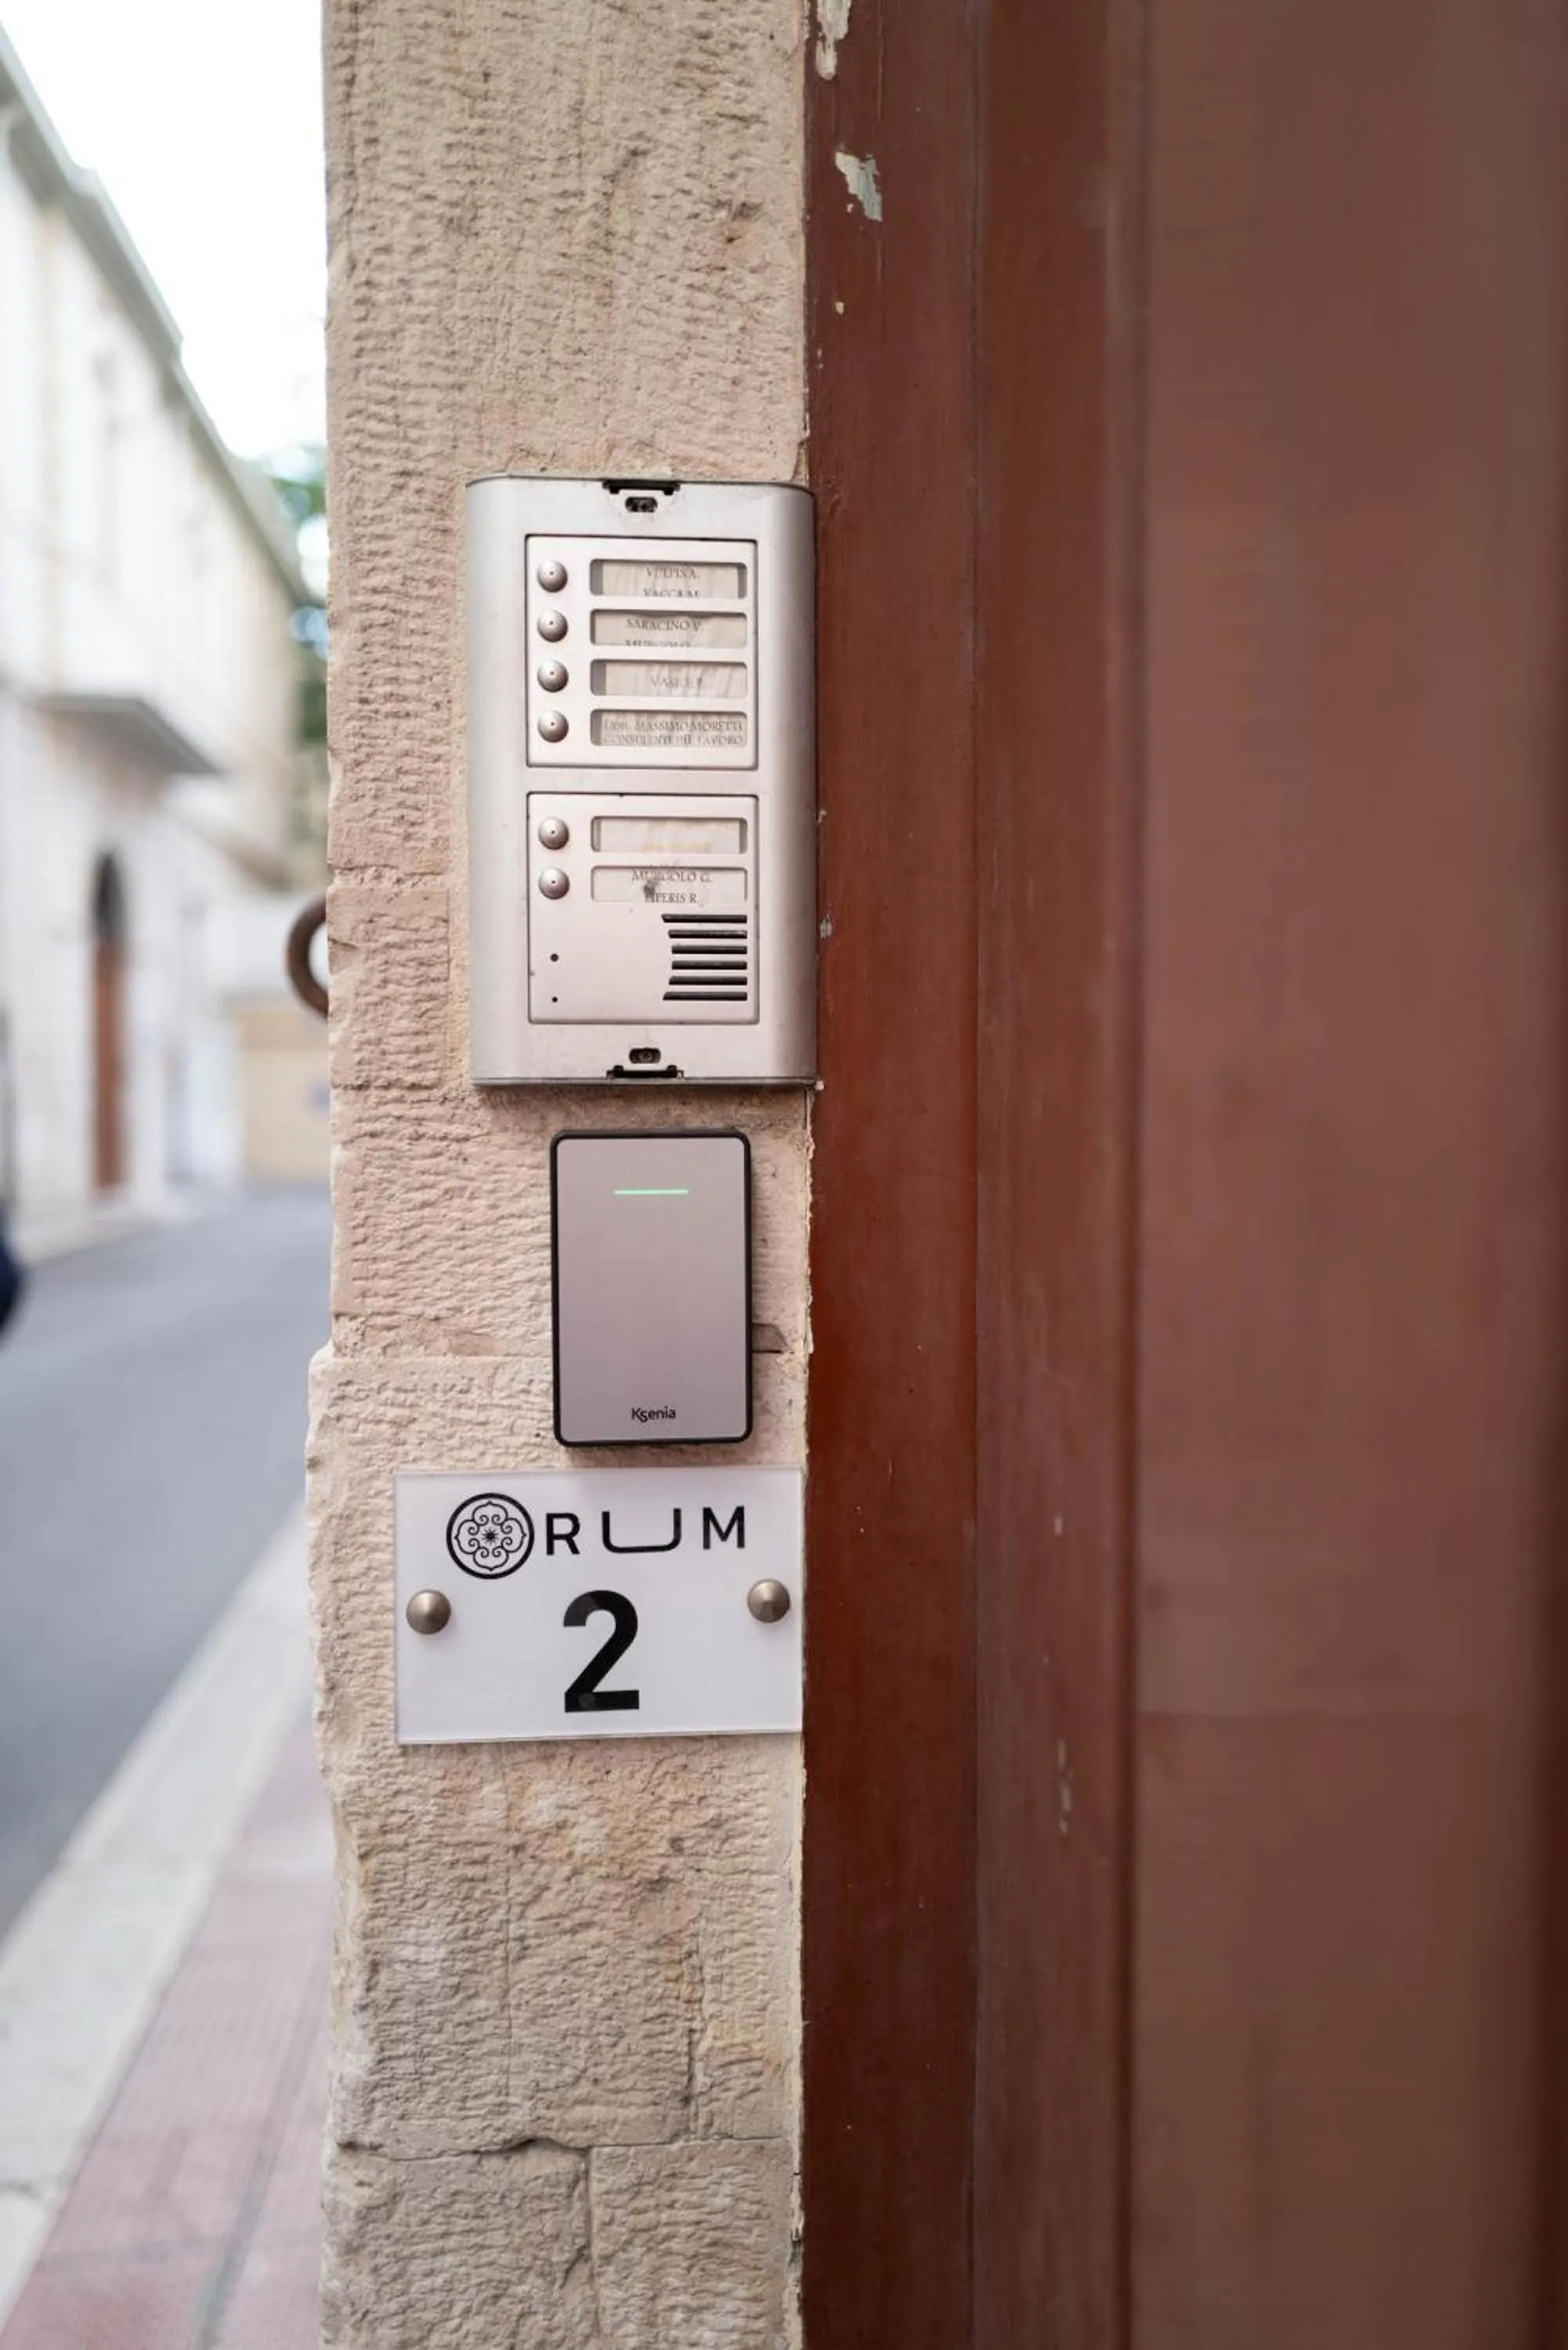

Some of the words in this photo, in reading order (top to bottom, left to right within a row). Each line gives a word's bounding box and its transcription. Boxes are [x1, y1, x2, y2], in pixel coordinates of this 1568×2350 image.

[626, 617, 690, 631] SARACINO
[634, 720, 688, 732] MASSIMO
[690, 721, 742, 732] MORETTI
[631, 869, 696, 883] MURGOLO
[631, 1405, 676, 1423] Ksenia
[563, 1589, 640, 1713] 2
